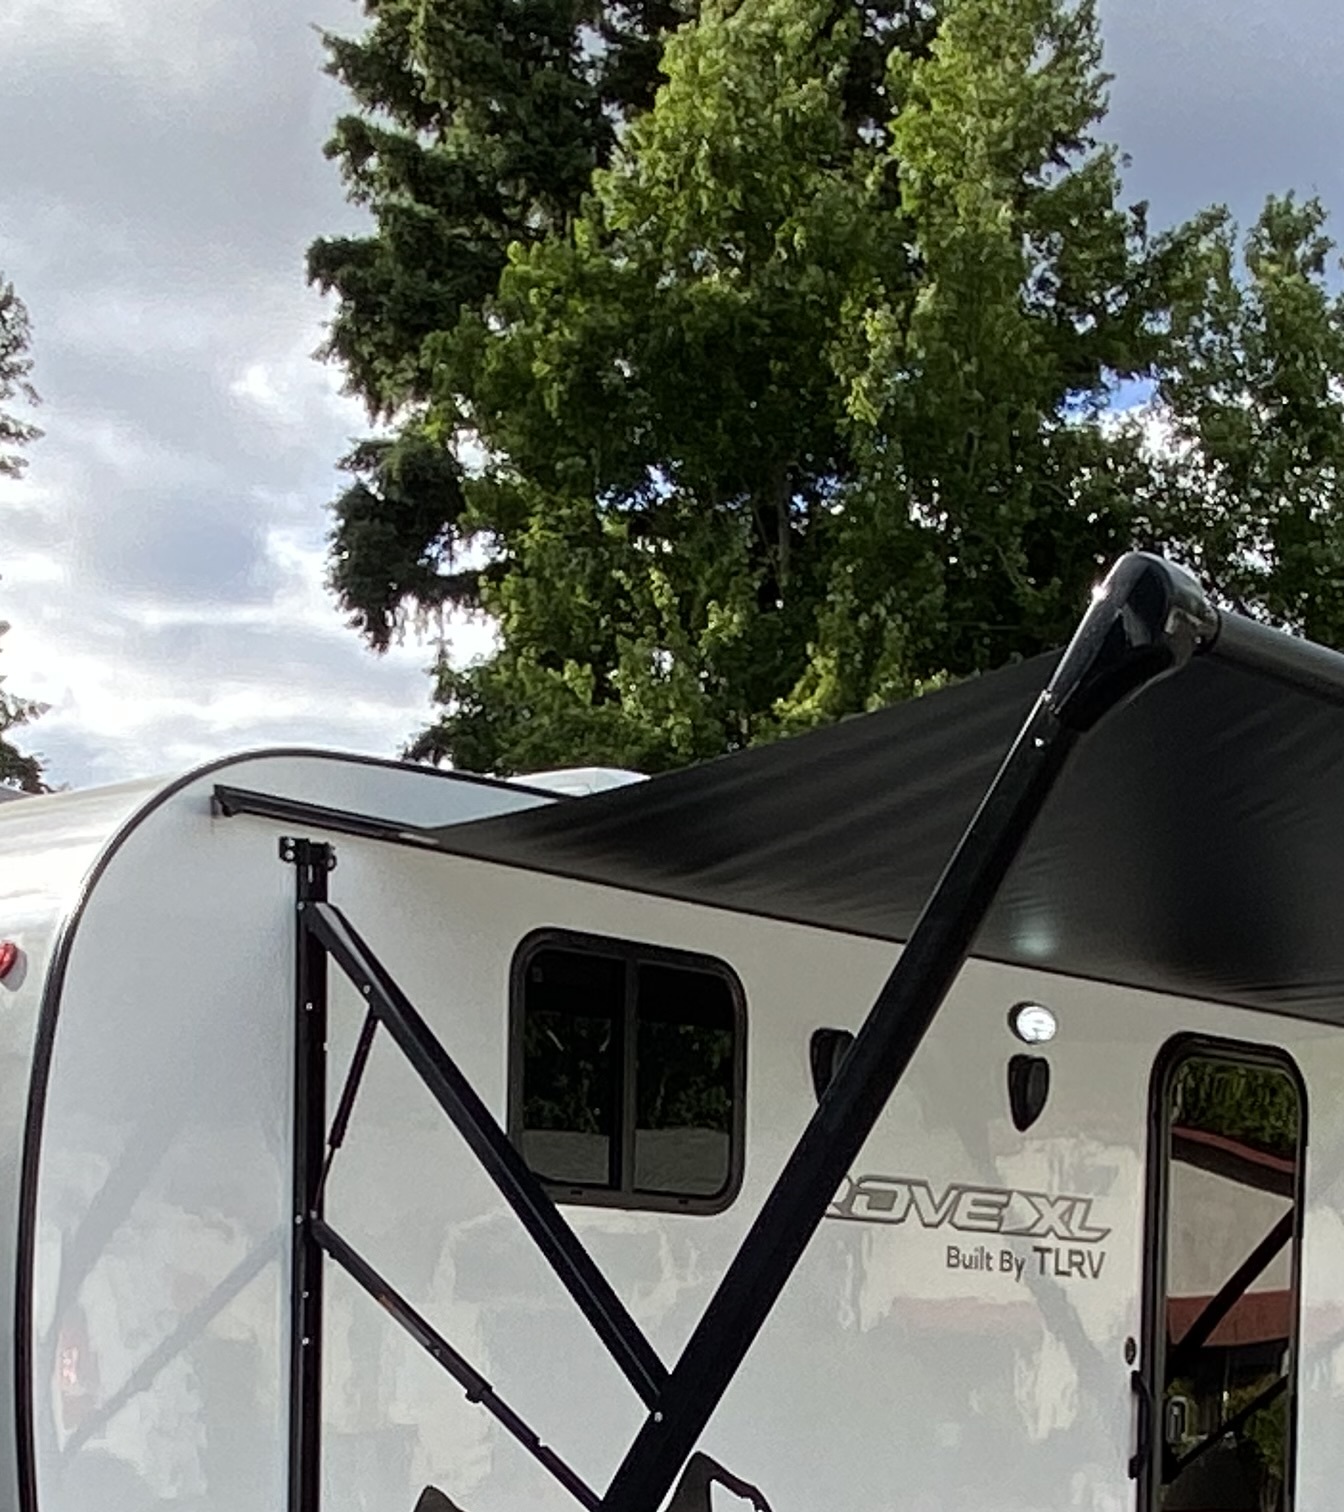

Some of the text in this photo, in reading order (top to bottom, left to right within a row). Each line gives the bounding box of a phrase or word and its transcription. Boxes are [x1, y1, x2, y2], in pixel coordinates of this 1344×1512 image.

[1027, 1191, 1112, 1242] XL
[945, 1245, 1106, 1282] Built By TLRV
